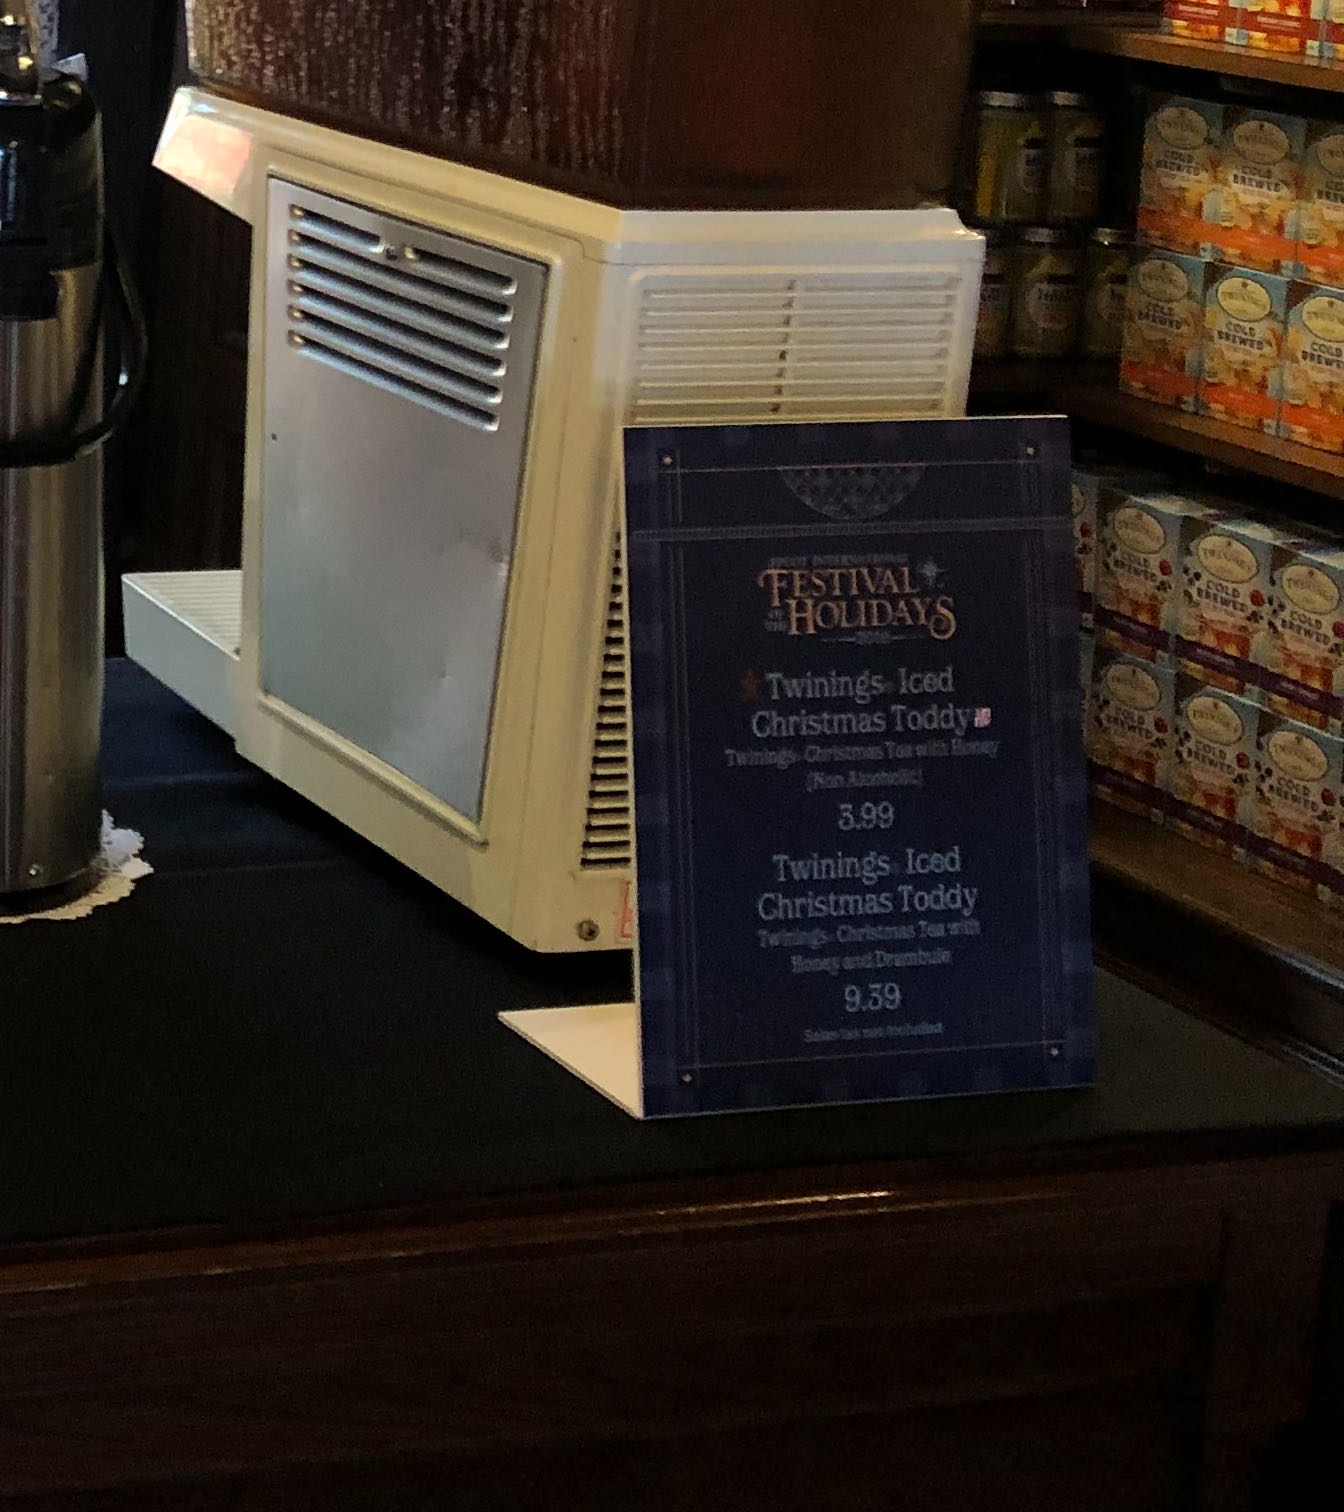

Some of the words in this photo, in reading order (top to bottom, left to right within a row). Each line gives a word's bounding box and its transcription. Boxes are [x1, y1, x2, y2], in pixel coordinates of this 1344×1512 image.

[1217, 329, 1264, 348] BREWED
[1225, 320, 1256, 335] COLD
[1301, 349, 1344, 365] BREWE
[1311, 339, 1342, 354] COLD
[757, 566, 920, 609] FESTIVAL
[1196, 587, 1248, 612] BREWED
[1206, 580, 1241, 598] COLD
[784, 596, 957, 641] HOLIDAYS
[767, 669, 885, 704] Twinings
[898, 667, 955, 696] Iced
[751, 709, 887, 739] Christmas
[891, 706, 972, 738] Toddy
[772, 851, 890, 886] Twinings
[906, 846, 962, 875] Iced
[757, 891, 894, 922] Christmas
[898, 884, 979, 918] Toddy
